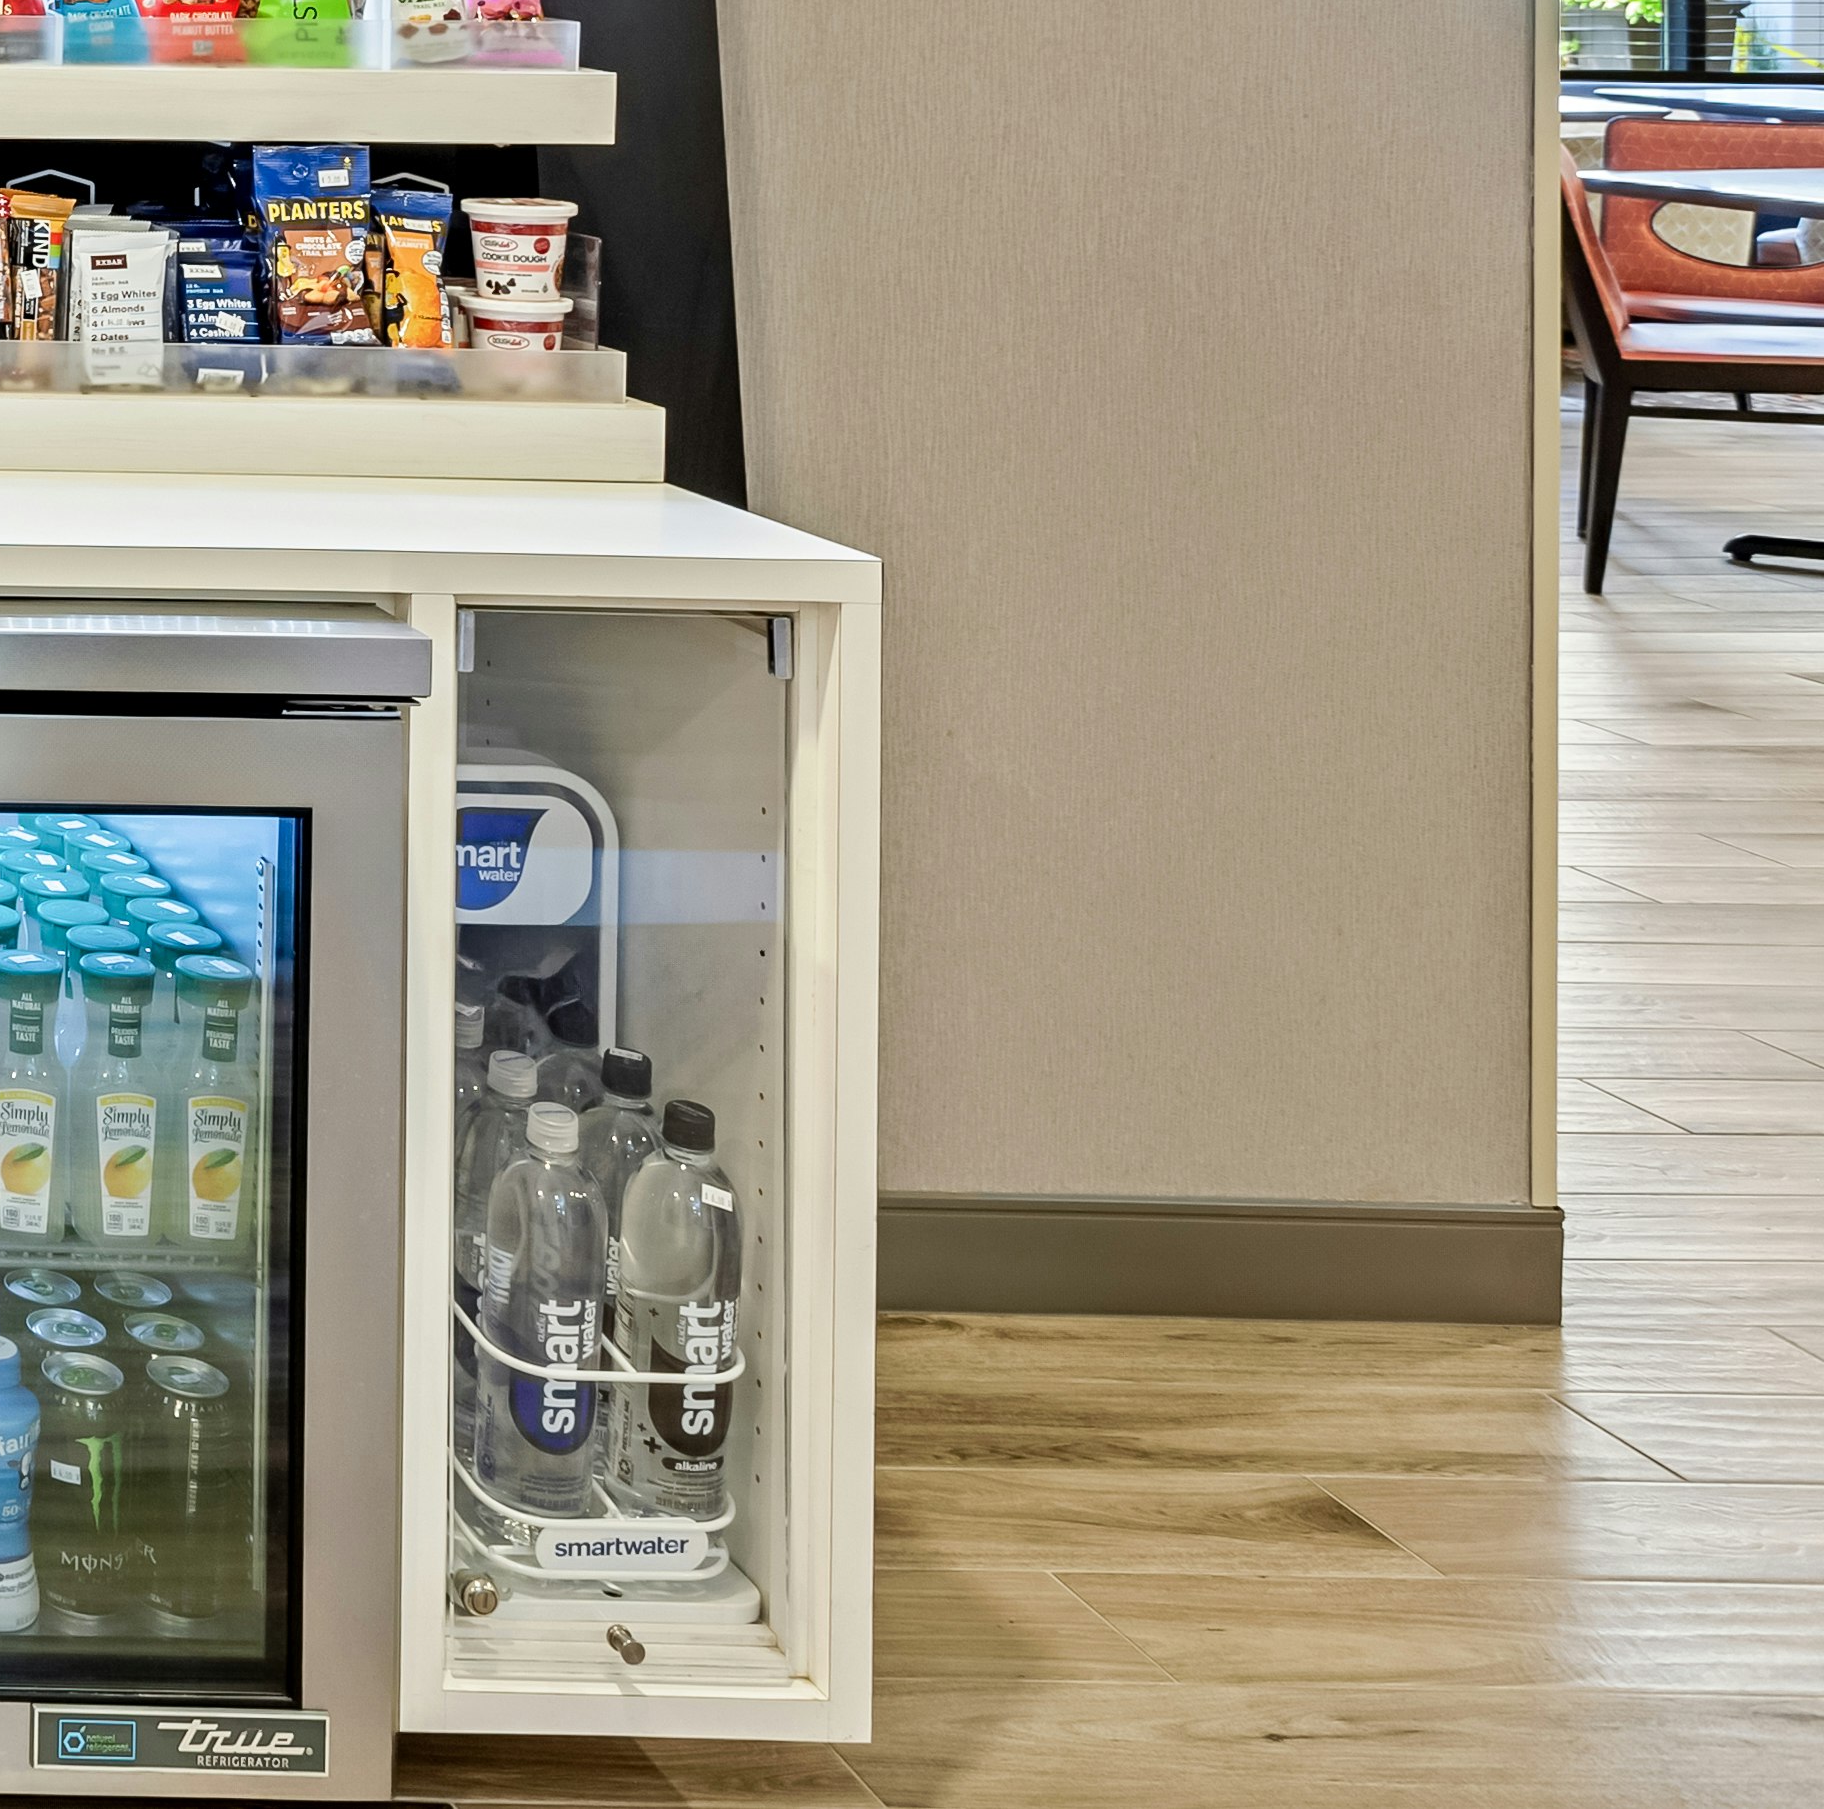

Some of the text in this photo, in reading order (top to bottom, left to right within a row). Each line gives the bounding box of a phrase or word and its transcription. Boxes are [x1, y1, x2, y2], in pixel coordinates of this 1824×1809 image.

[267, 199, 366, 223] PLANTERS
[32, 219, 50, 269] KIND
[100, 332, 129, 342] Dates
[478, 869, 521, 883] water
[0, 1101, 49, 1129] Simply
[102, 1105, 151, 1132] Simply
[192, 1108, 242, 1137] Simply
[0, 1120, 53, 1138] Lemonade
[102, 1124, 152, 1142] Lemonade
[191, 1127, 243, 1143] Lemonade
[581, 1299, 597, 1360] water
[538, 1299, 583, 1435] smart
[679, 1299, 722, 1435] smart
[674, 1459, 719, 1472] alkaline
[554, 1535, 690, 1558] smartwater
[86, 1733, 116, 1743] natural
[196, 1754, 290, 1768] REFRIGERATOR
